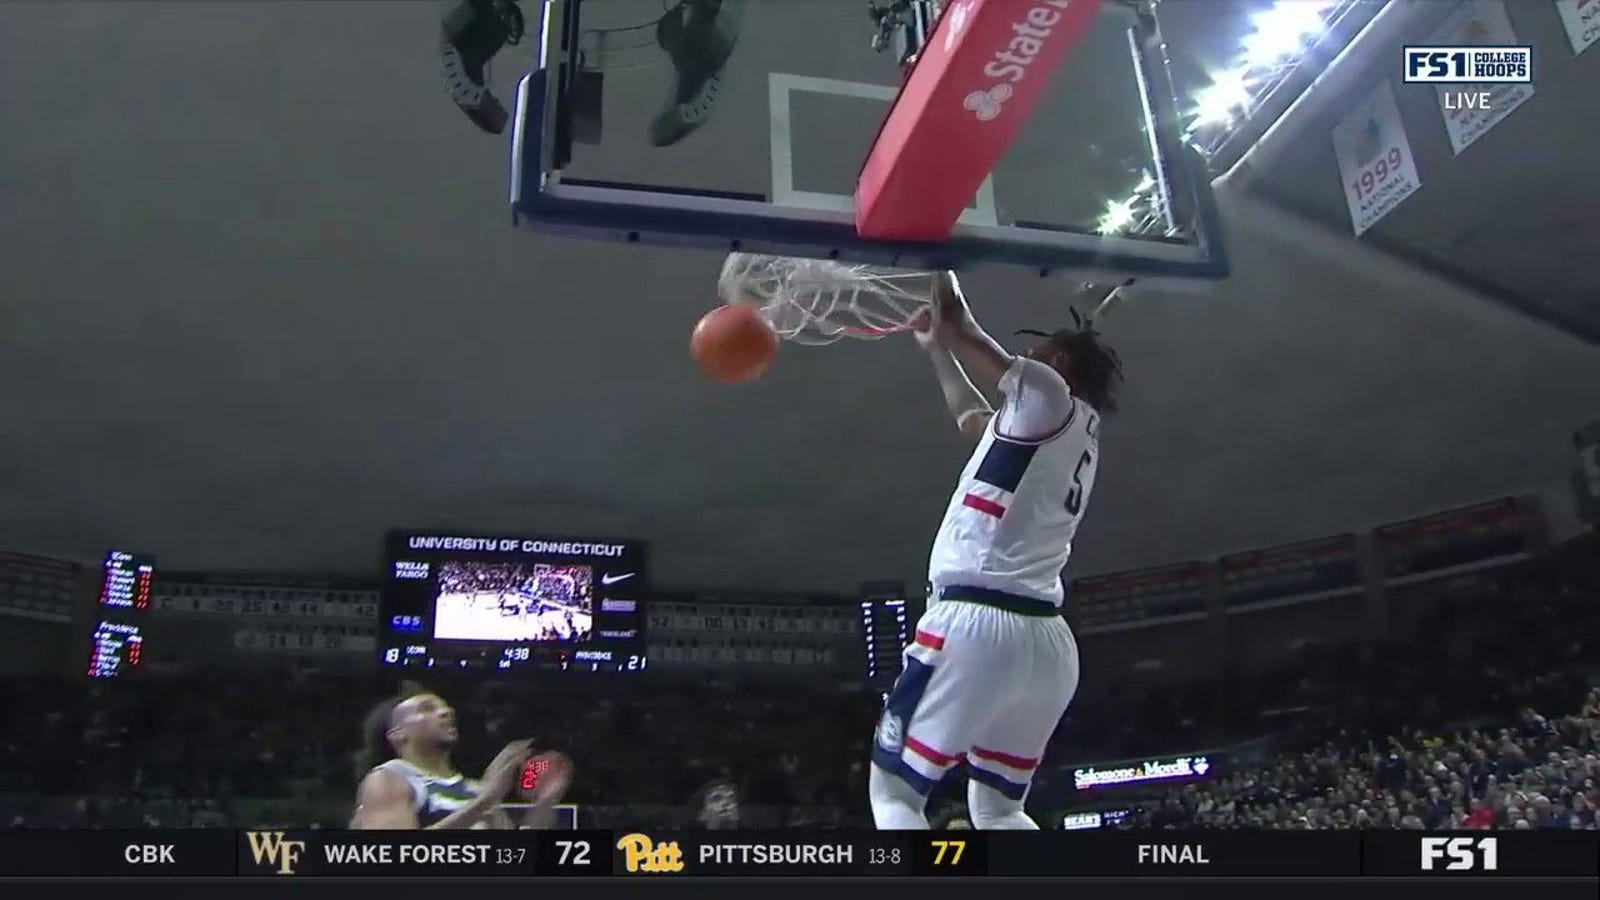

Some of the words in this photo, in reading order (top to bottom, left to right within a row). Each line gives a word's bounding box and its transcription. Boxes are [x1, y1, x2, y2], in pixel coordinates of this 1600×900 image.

[984, 6, 1062, 83] State
[1352, 148, 1402, 201] 1999
[1064, 449, 1091, 517] 5
[409, 537, 497, 551] UNIVERSITY
[500, 539, 519, 551] OF
[522, 540, 625, 556] CONNECTICUT
[628, 655, 646, 670] 21
